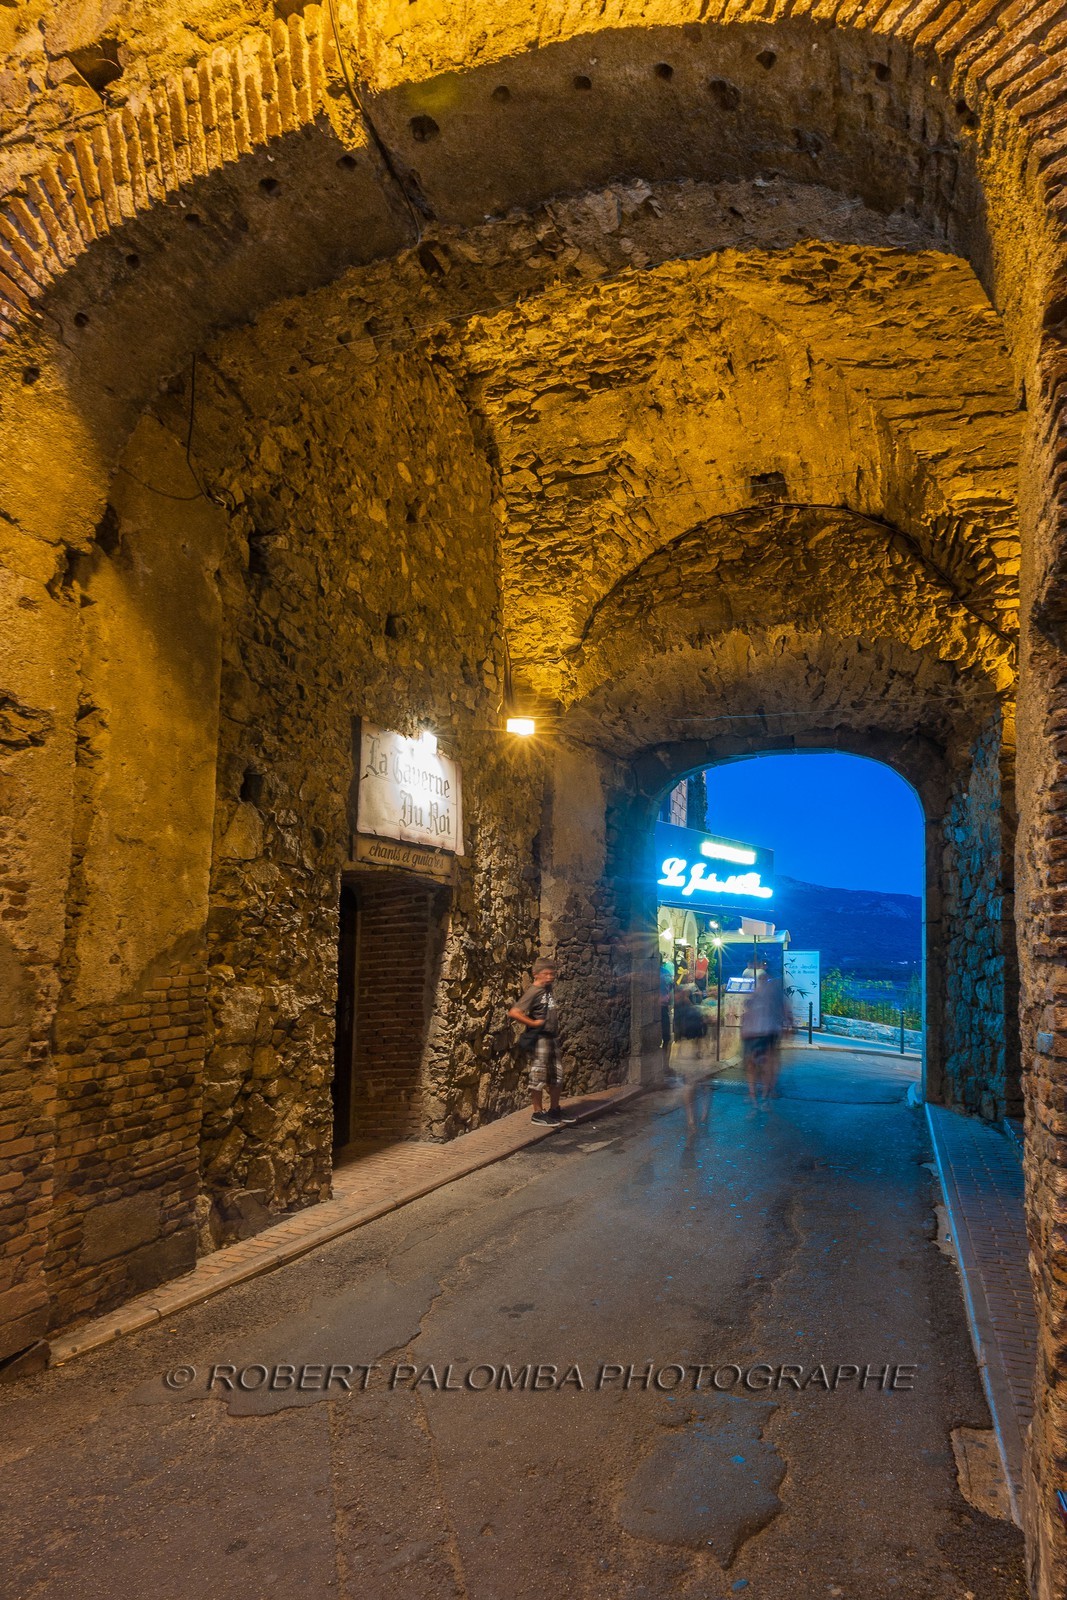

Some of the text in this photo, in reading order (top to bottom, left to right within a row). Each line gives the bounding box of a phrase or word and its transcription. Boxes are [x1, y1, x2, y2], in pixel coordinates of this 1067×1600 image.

[366, 735, 450, 799] La Taverne
[399, 790, 451, 835] Du Roi
[369, 842, 401, 861] chants
[402, 850, 411, 862] et
